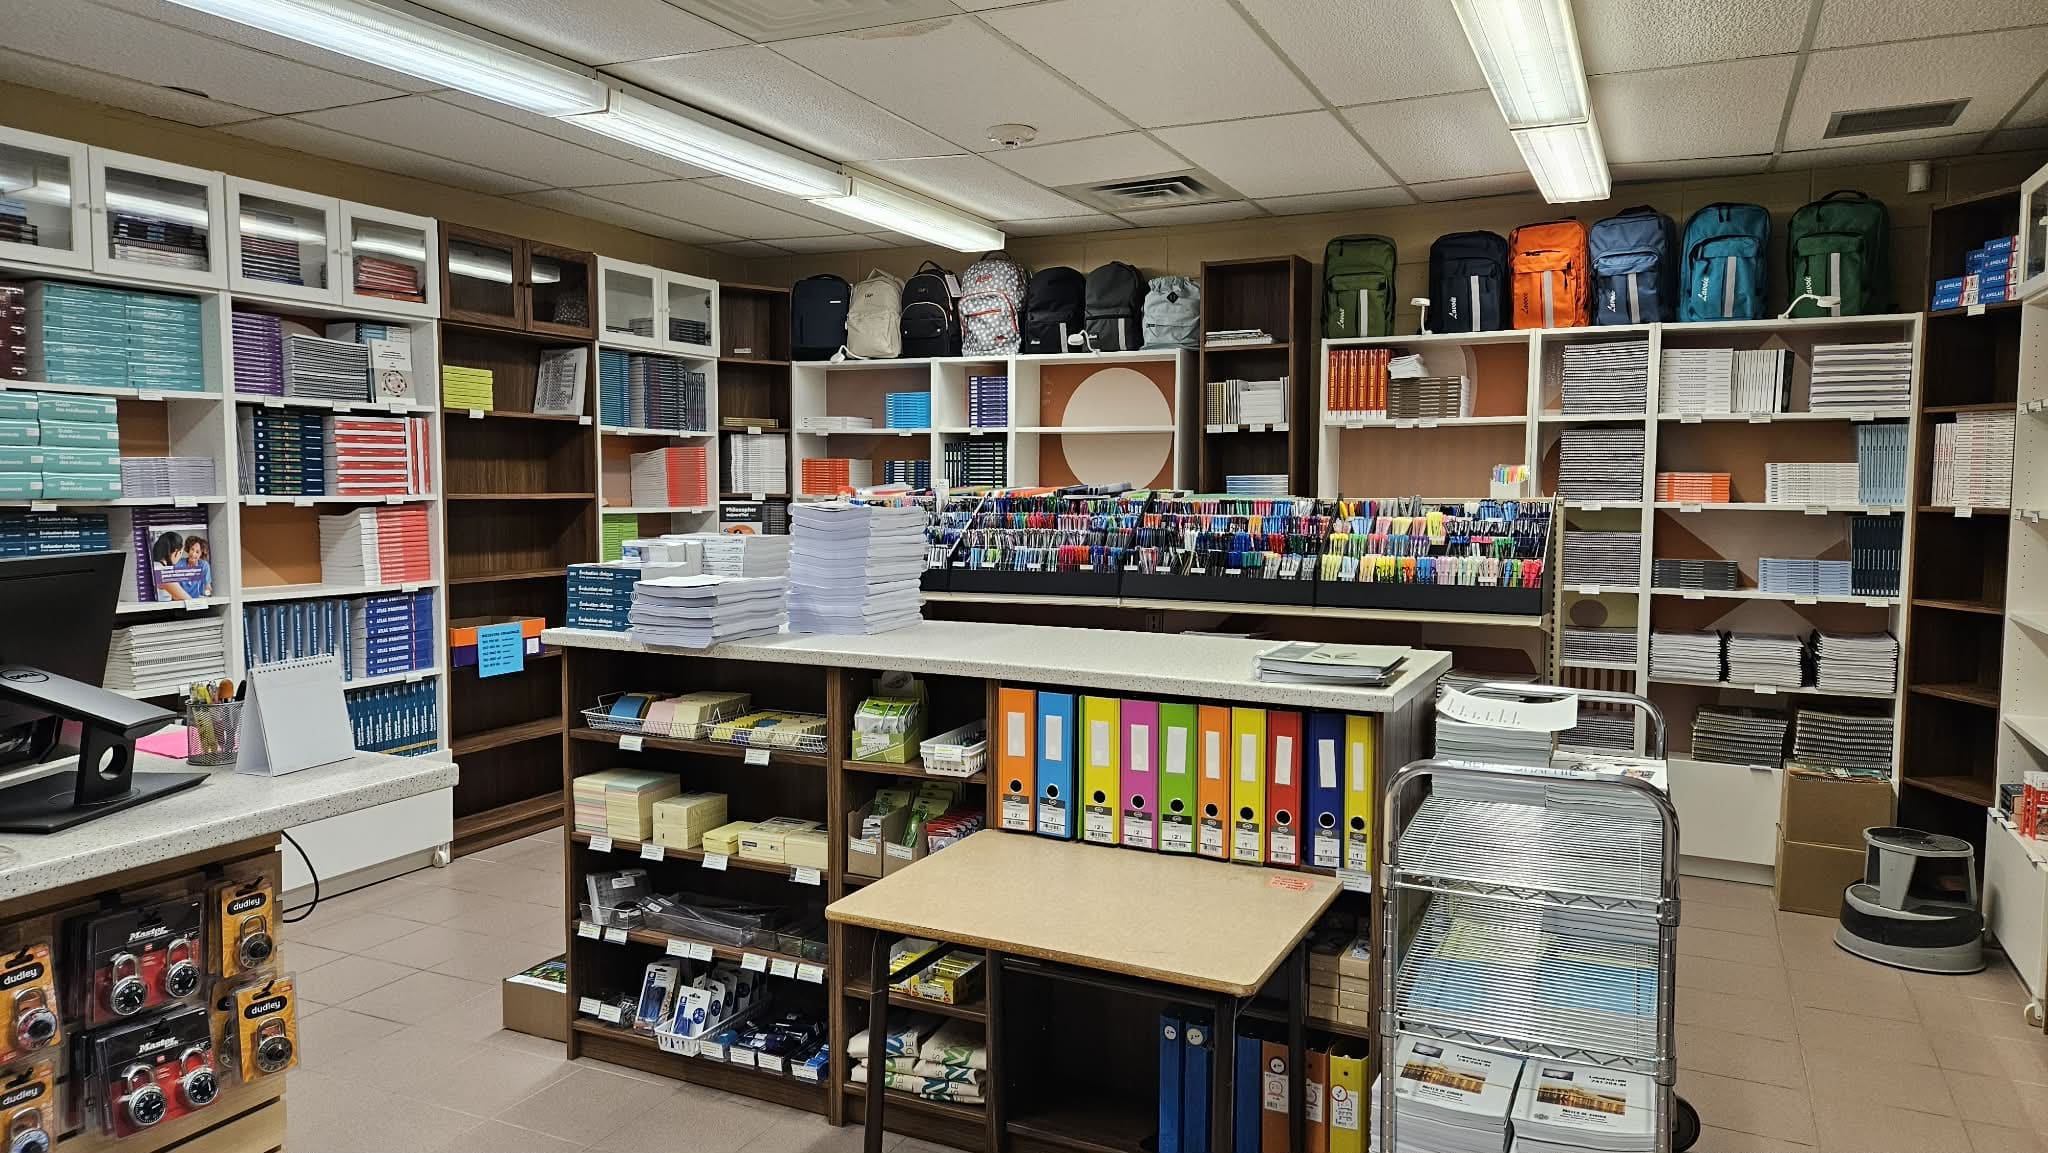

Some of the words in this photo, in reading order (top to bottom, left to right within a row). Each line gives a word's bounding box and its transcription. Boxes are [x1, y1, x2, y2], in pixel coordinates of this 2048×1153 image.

[1804, 276, 1812, 294] avoie
[233, 897, 260, 911] dudley
[129, 926, 168, 941] Master
[3, 968, 37, 985] dudley
[251, 1001, 281, 1015] dudley
[138, 1037, 178, 1053] Master
[2, 1087, 38, 1105] dudley
